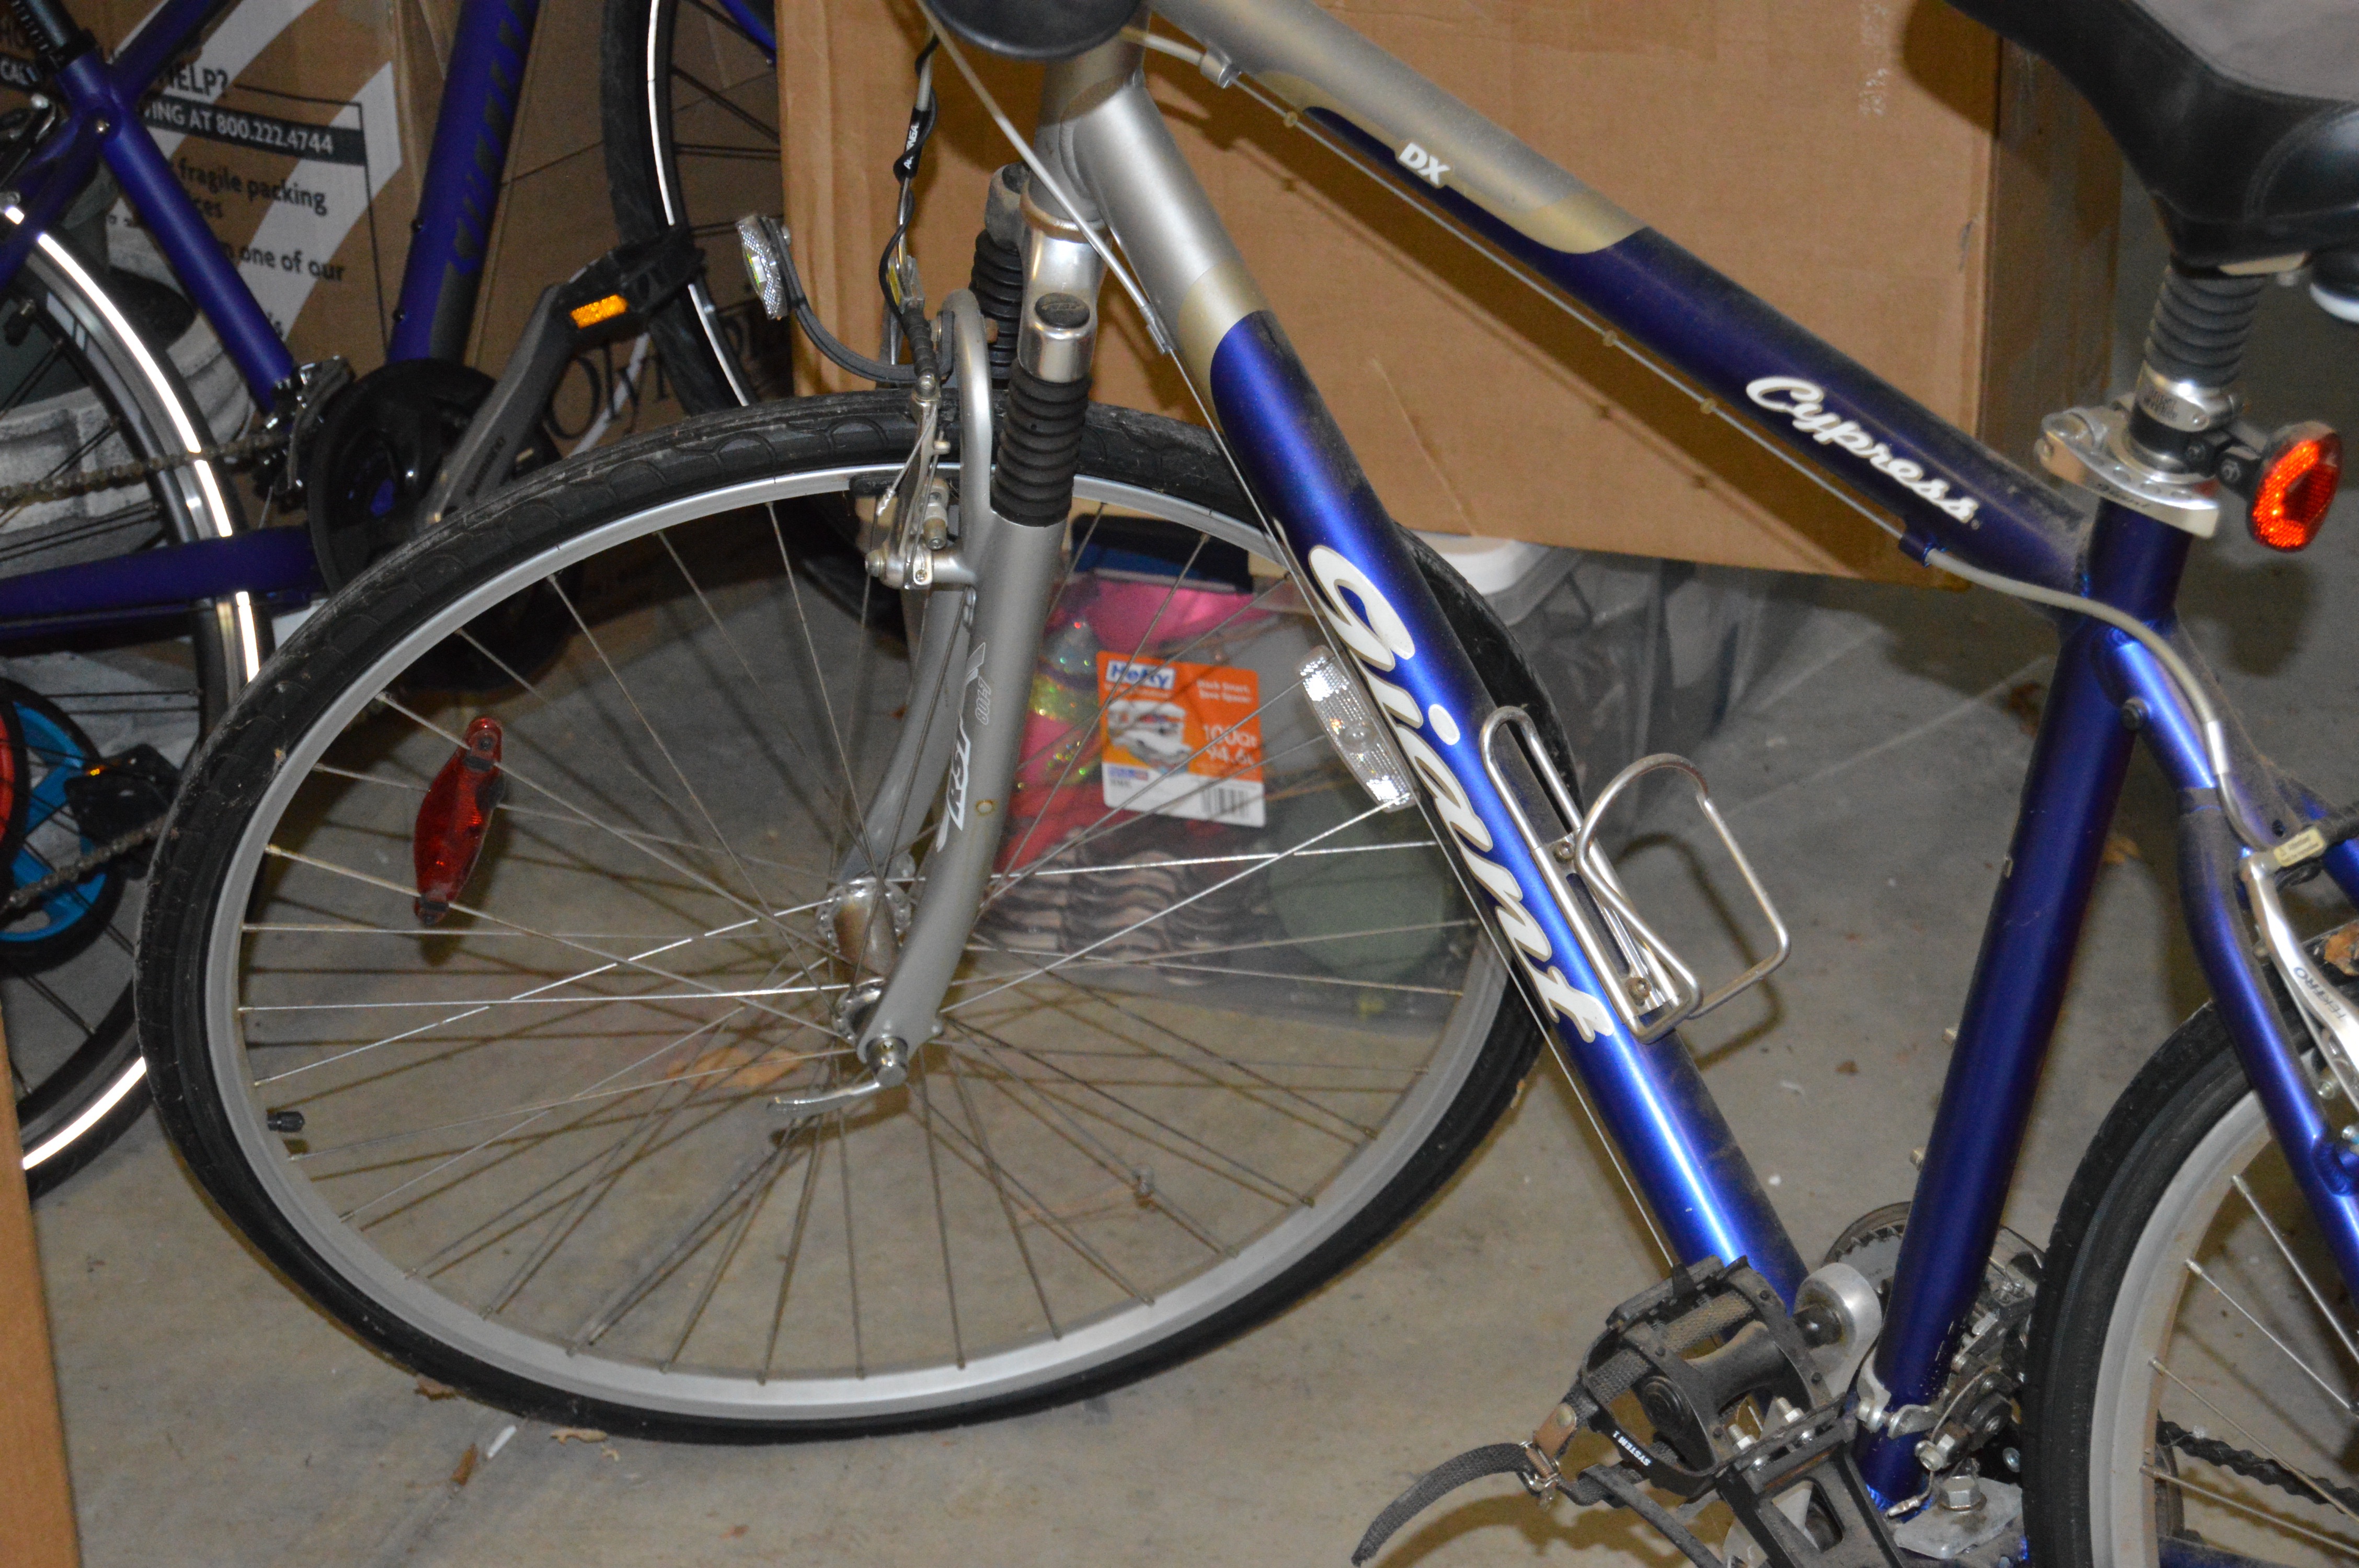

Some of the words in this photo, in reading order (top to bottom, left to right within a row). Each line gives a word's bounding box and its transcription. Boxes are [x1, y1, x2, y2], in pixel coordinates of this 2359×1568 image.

[168, 64, 228, 98] ELP?
[189, 108, 212, 132] AT
[216, 113, 335, 155] 800.222.4744
[1398, 142, 1451, 186] DX
[177, 157, 242, 194] fragile
[247, 178, 328, 216] packing
[240, 245, 276, 269] one
[280, 249, 303, 273] of
[308, 260, 347, 283] our
[1745, 375, 1980, 524] Cypress
[1617, 1436, 1652, 1467] SYSTEM
